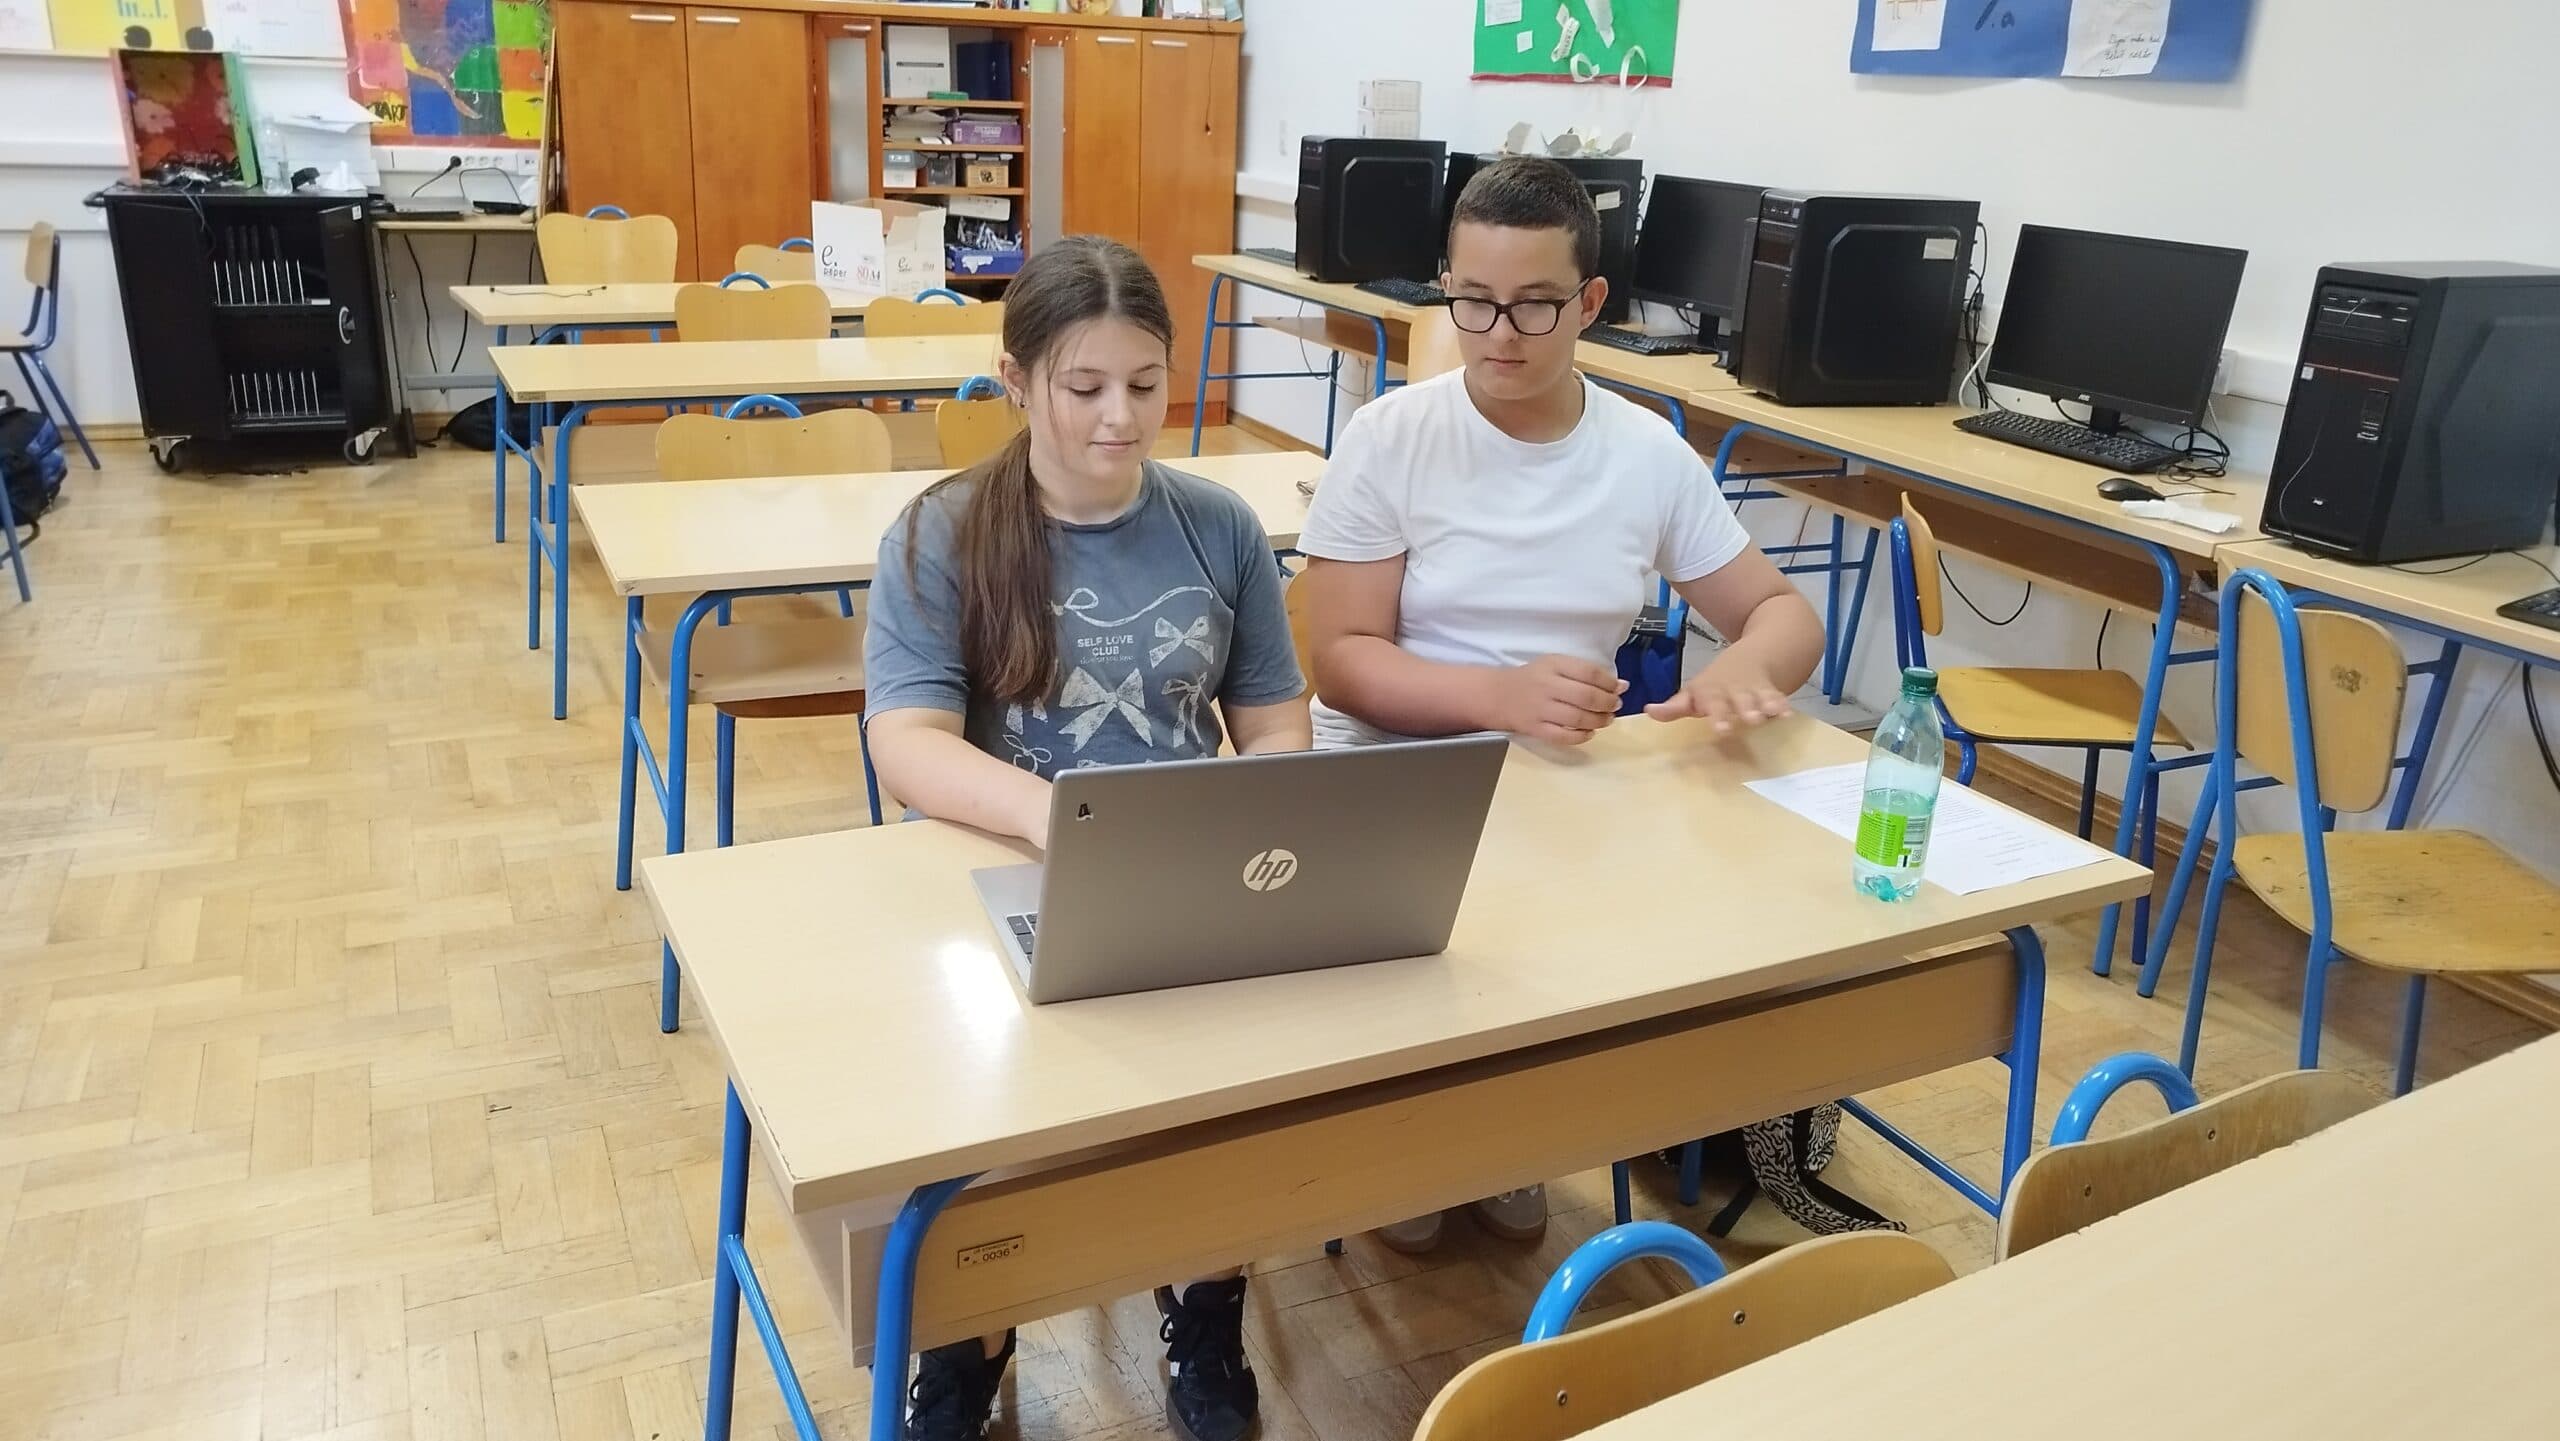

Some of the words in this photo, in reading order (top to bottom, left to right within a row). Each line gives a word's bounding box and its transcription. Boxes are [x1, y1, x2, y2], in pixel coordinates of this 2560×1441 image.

[1077, 636, 1103, 648] SELF
[1105, 634, 1134, 646] LOVE
[1092, 645, 1120, 656] CLUB
[1246, 849, 1295, 891] hp
[982, 1247, 1010, 1262] 0036
